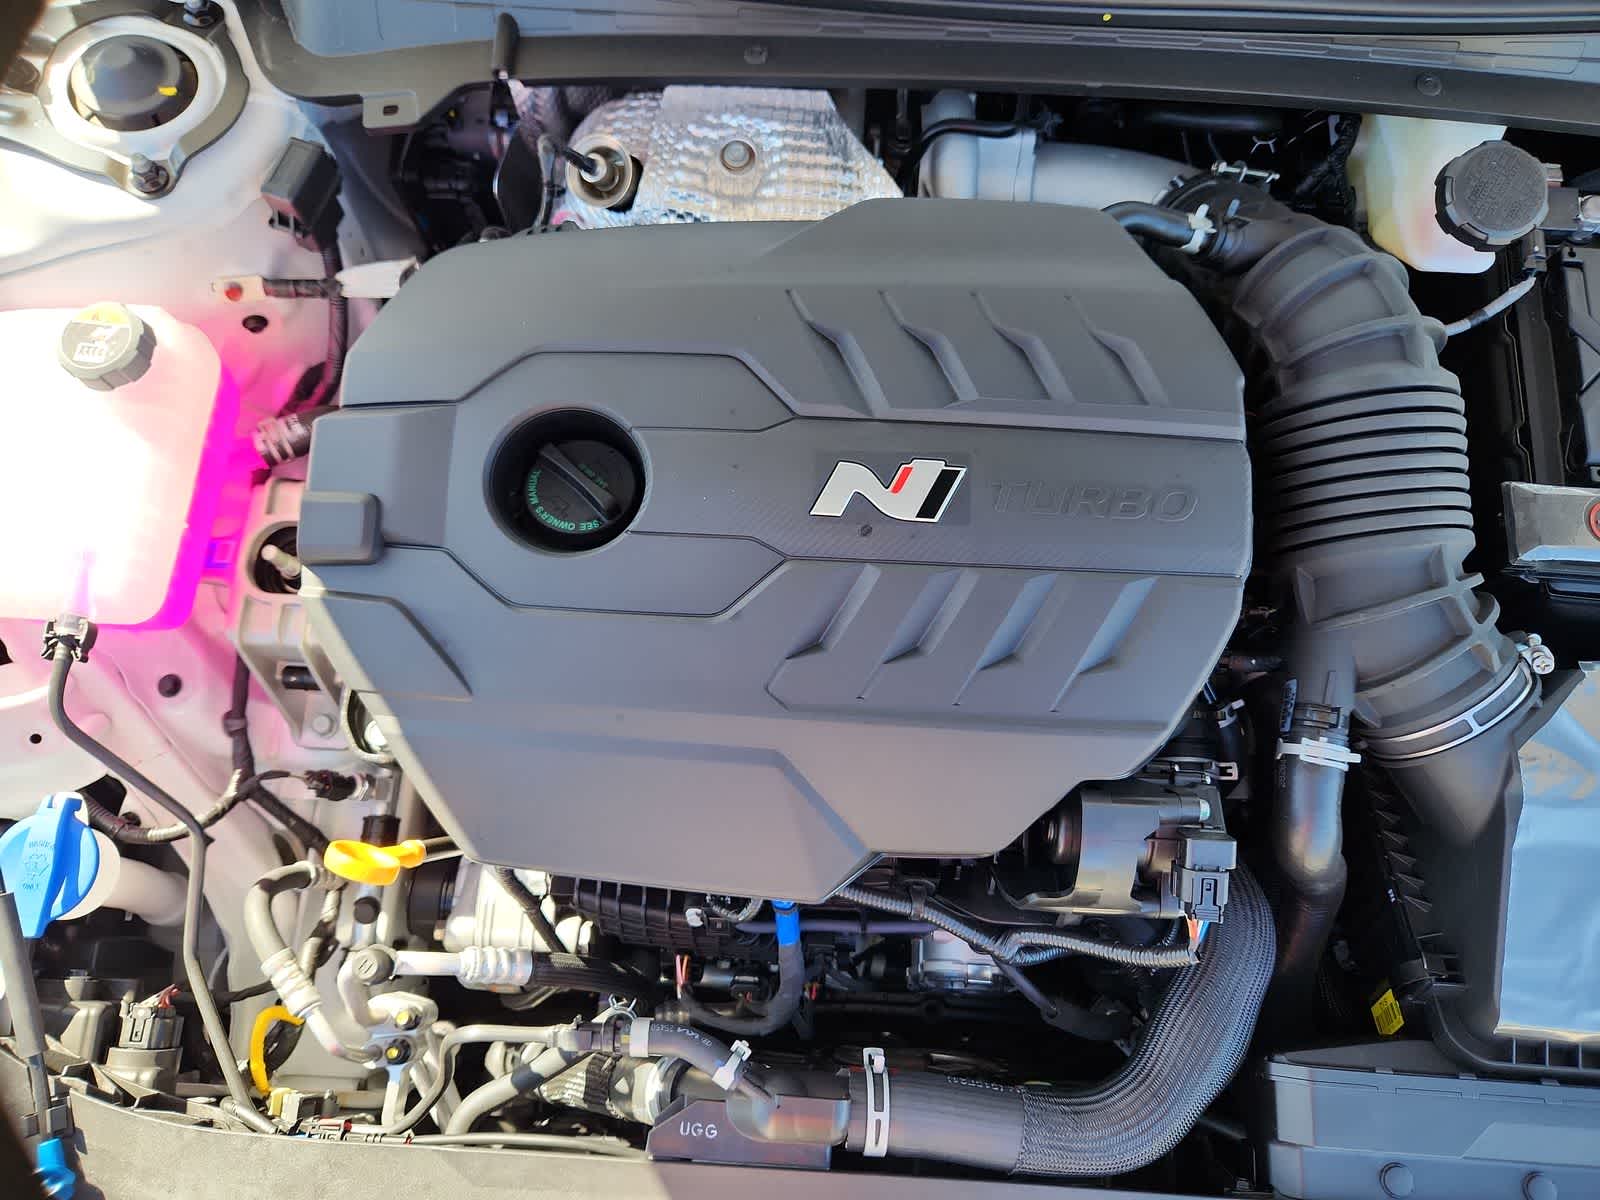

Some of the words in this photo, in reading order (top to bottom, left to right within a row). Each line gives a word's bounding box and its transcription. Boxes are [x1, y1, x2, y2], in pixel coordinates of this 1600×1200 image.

[527, 469, 542, 505] MANUAL
[990, 480, 1199, 522] TURBO
[535, 505, 576, 531] OWNER'S
[579, 519, 602, 531] SEE
[680, 1120, 718, 1138] UGG
